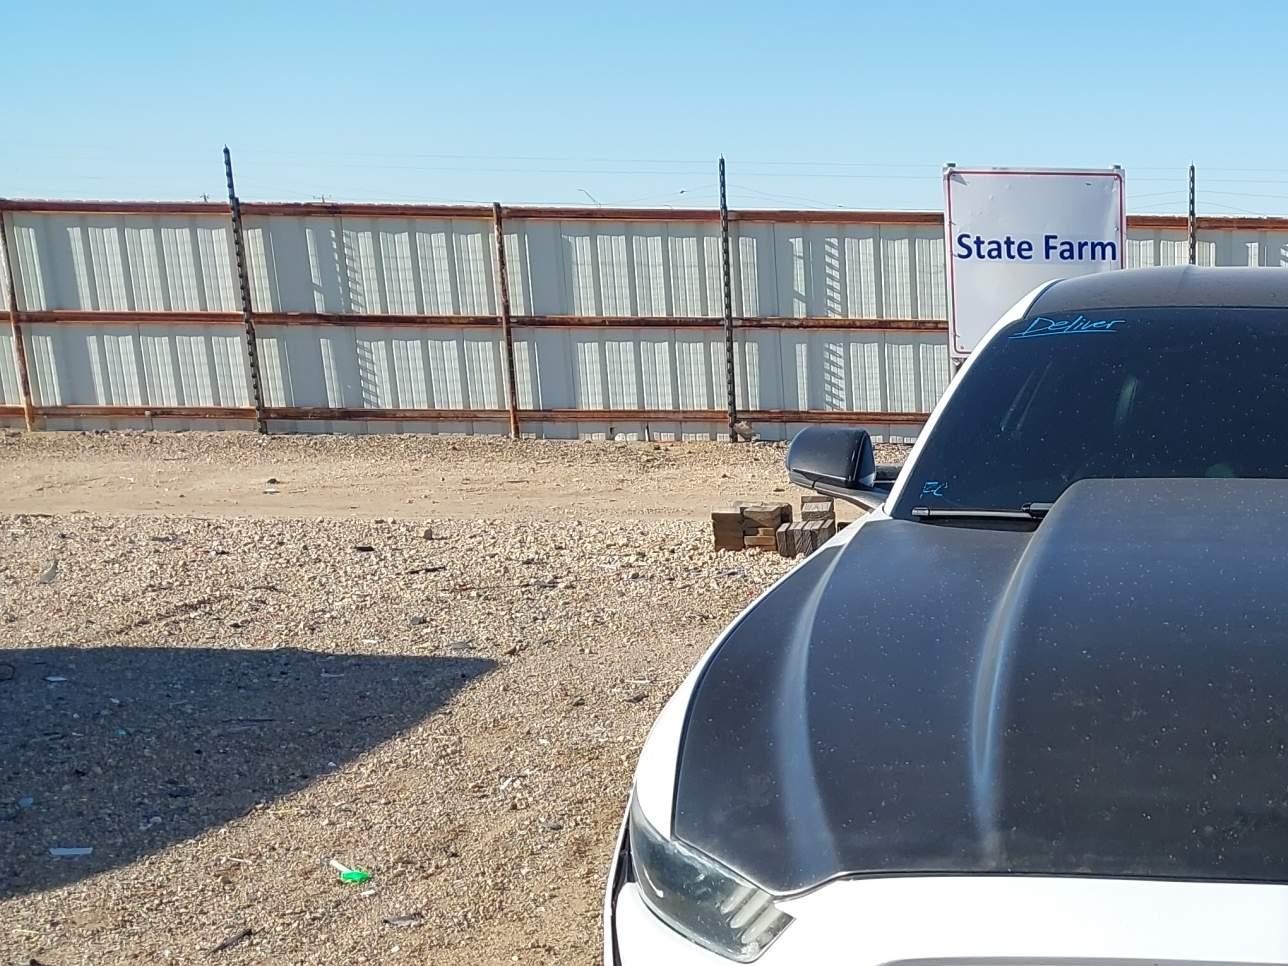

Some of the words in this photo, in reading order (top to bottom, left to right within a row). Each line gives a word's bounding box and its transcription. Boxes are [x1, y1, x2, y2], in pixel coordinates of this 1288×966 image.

[956, 233, 1033, 260] State
[1044, 235, 1117, 261] Farm
[1022, 315, 1127, 335] Deliver
